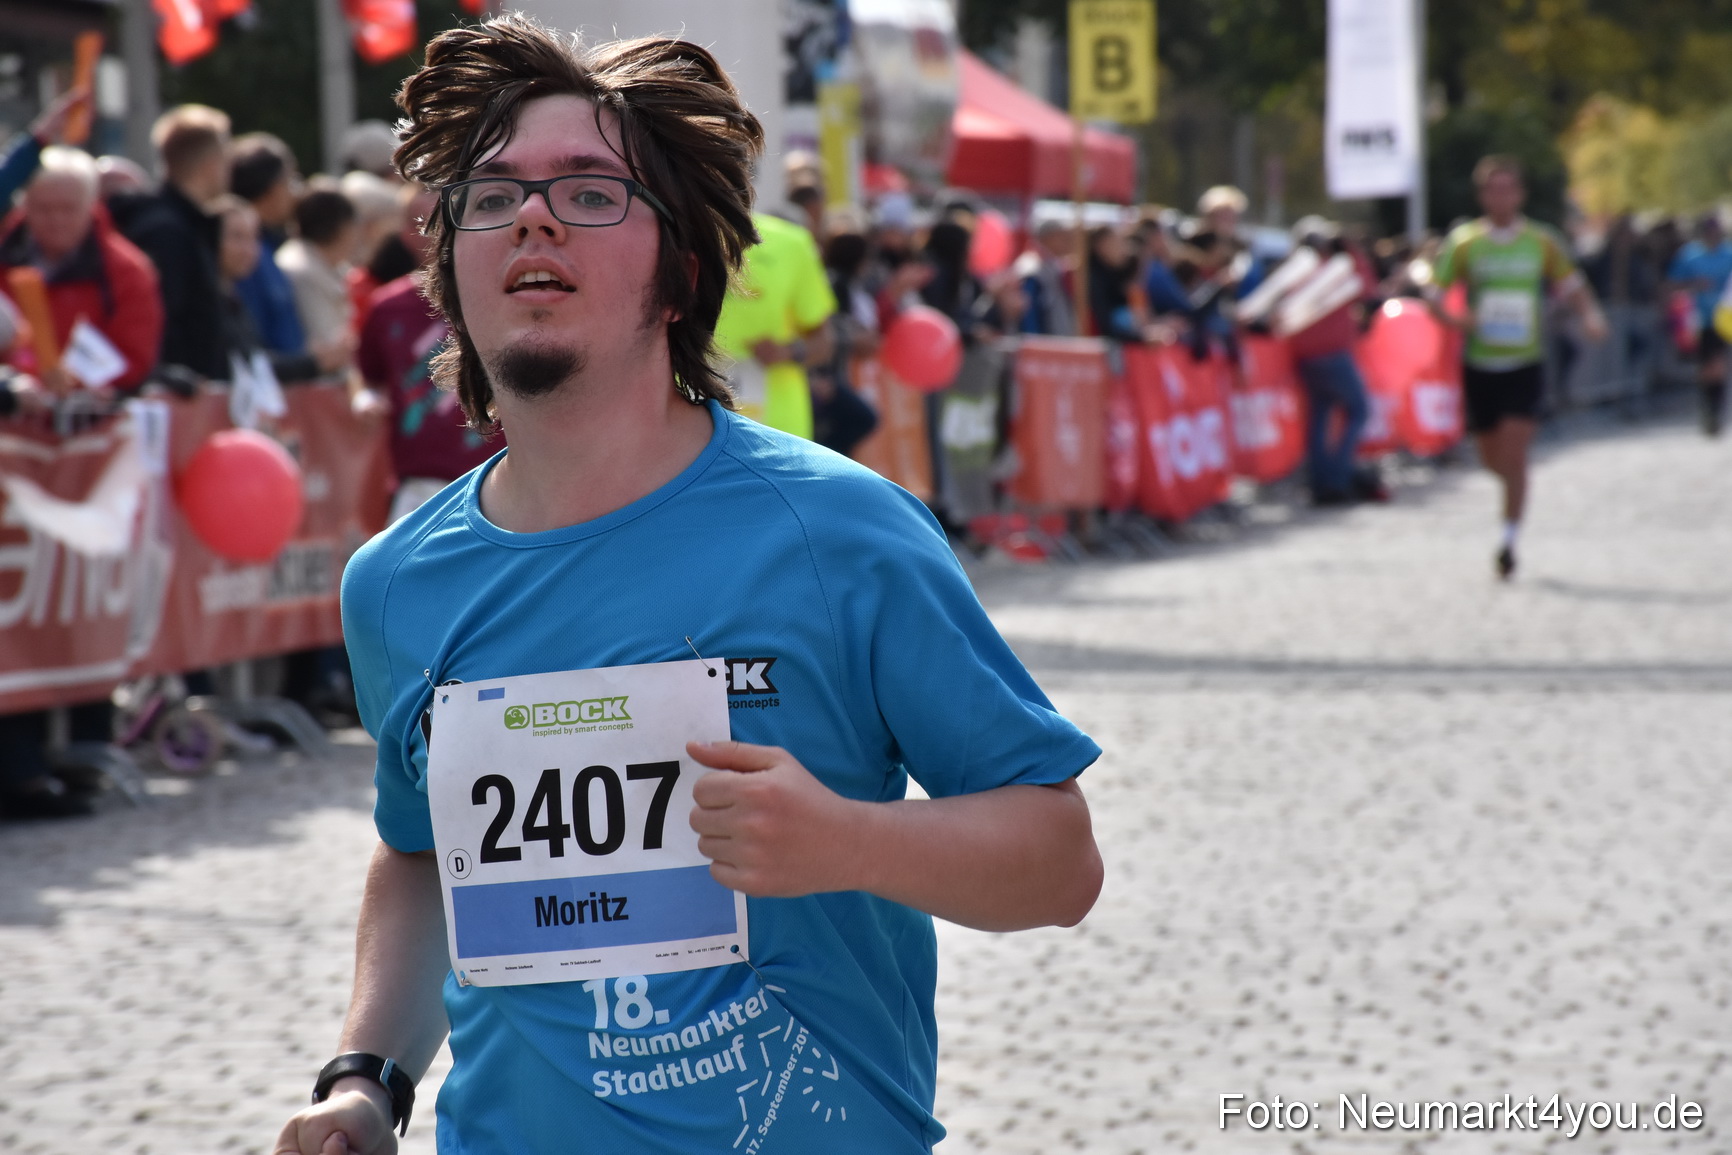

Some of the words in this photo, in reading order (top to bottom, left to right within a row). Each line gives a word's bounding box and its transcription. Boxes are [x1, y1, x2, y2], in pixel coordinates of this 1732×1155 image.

[1092, 36, 1133, 93] B
[532, 696, 632, 728] BOCK
[532, 727, 562, 738] inspired
[564, 727, 573, 736] by
[575, 725, 597, 734] smart
[598, 722, 634, 732] concepts
[728, 697, 780, 710] concepts
[471, 760, 681, 864] 2407
[454, 856, 465, 872] D
[534, 891, 629, 928] Moritz
[581, 975, 670, 1030] 18.
[588, 988, 769, 1059] Neumarkter
[592, 1034, 748, 1098] Stadtlauf
[758, 1054, 798, 1136] September
[792, 1026, 809, 1055] 201
